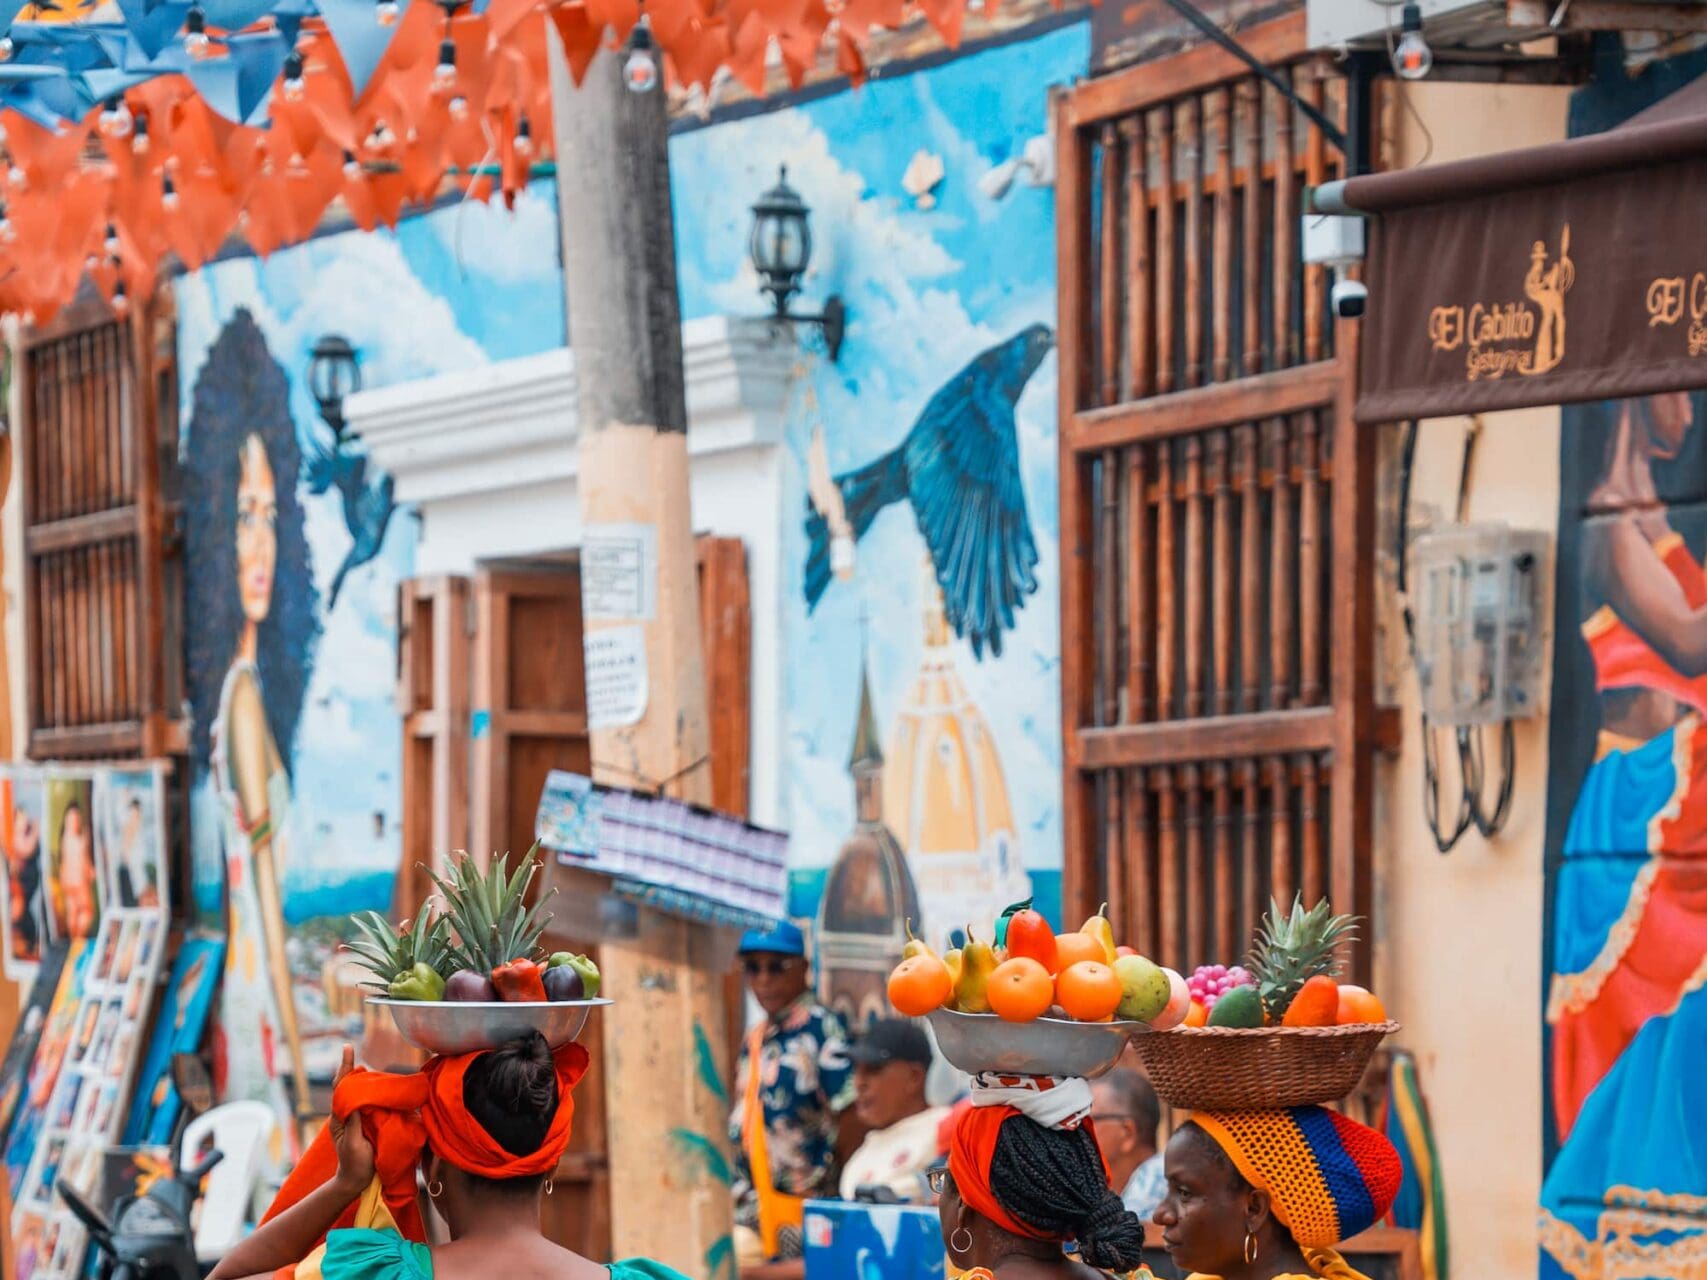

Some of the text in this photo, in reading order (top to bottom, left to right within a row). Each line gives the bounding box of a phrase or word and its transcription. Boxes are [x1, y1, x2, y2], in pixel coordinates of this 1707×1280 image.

[1428, 301, 1534, 351] El Cabildo
[1647, 276, 1685, 327] El
